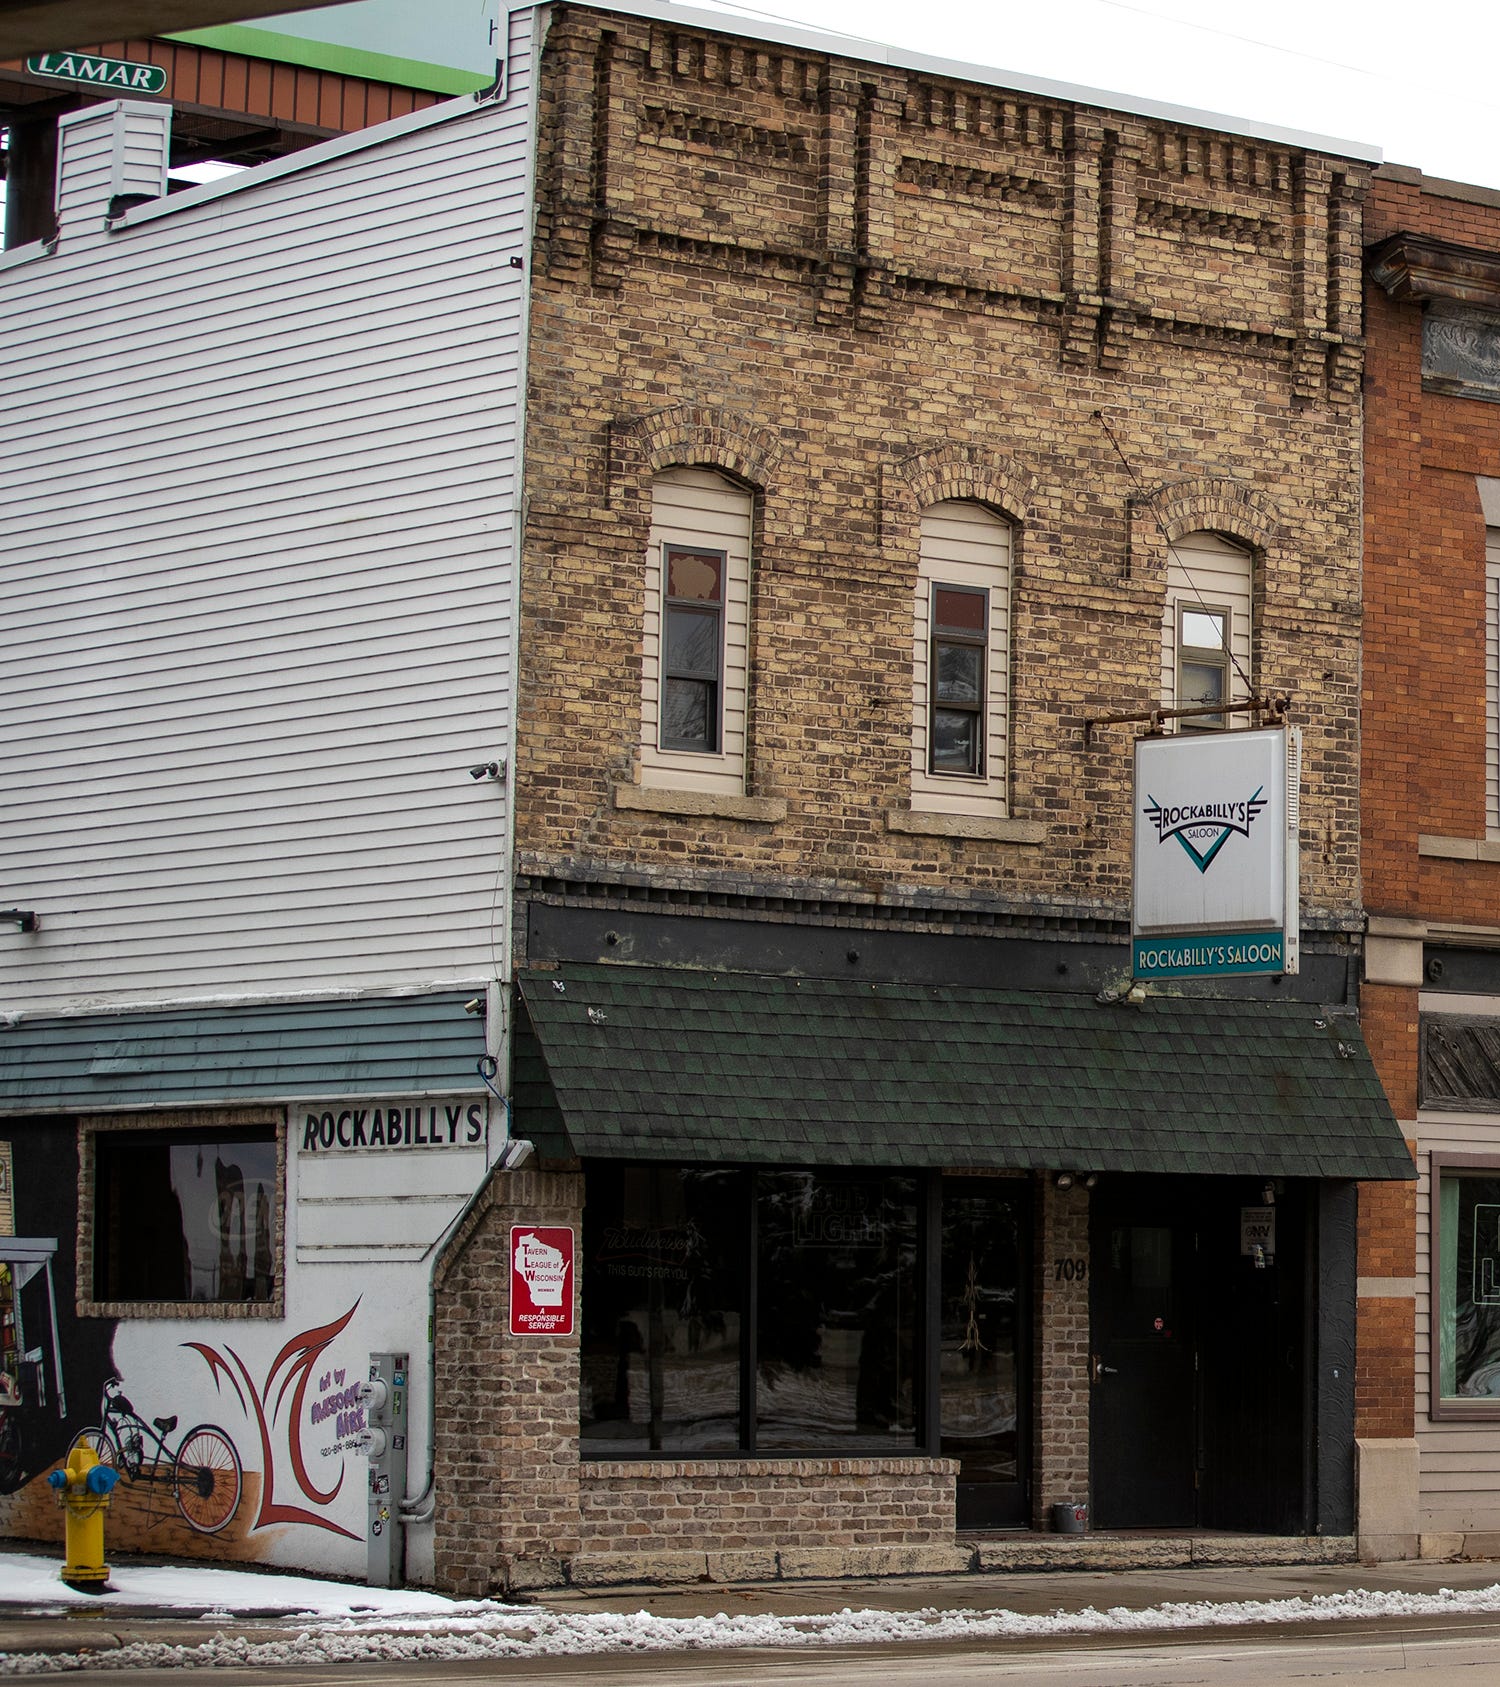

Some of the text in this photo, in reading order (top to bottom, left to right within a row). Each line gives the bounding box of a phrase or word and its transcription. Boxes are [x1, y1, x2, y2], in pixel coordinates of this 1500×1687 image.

[38, 54, 153, 89] LAMAR
[1163, 801, 1246, 828] ROCKABILLY'S
[1188, 827, 1219, 839] SALOON
[1138, 943, 1282, 970] ROCKABILLY'S SALOON
[303, 1103, 483, 1151] ROCKABILLYS
[522, 1244, 548, 1255] TAVERN
[524, 1257, 559, 1269] LEAGUE of
[525, 1270, 564, 1281] WISCONSIN
[1054, 1258, 1087, 1281] 709
[540, 1307, 545, 1315] A
[518, 1315, 565, 1323] RESPONSIBLE
[528, 1322, 555, 1330] SERVER
